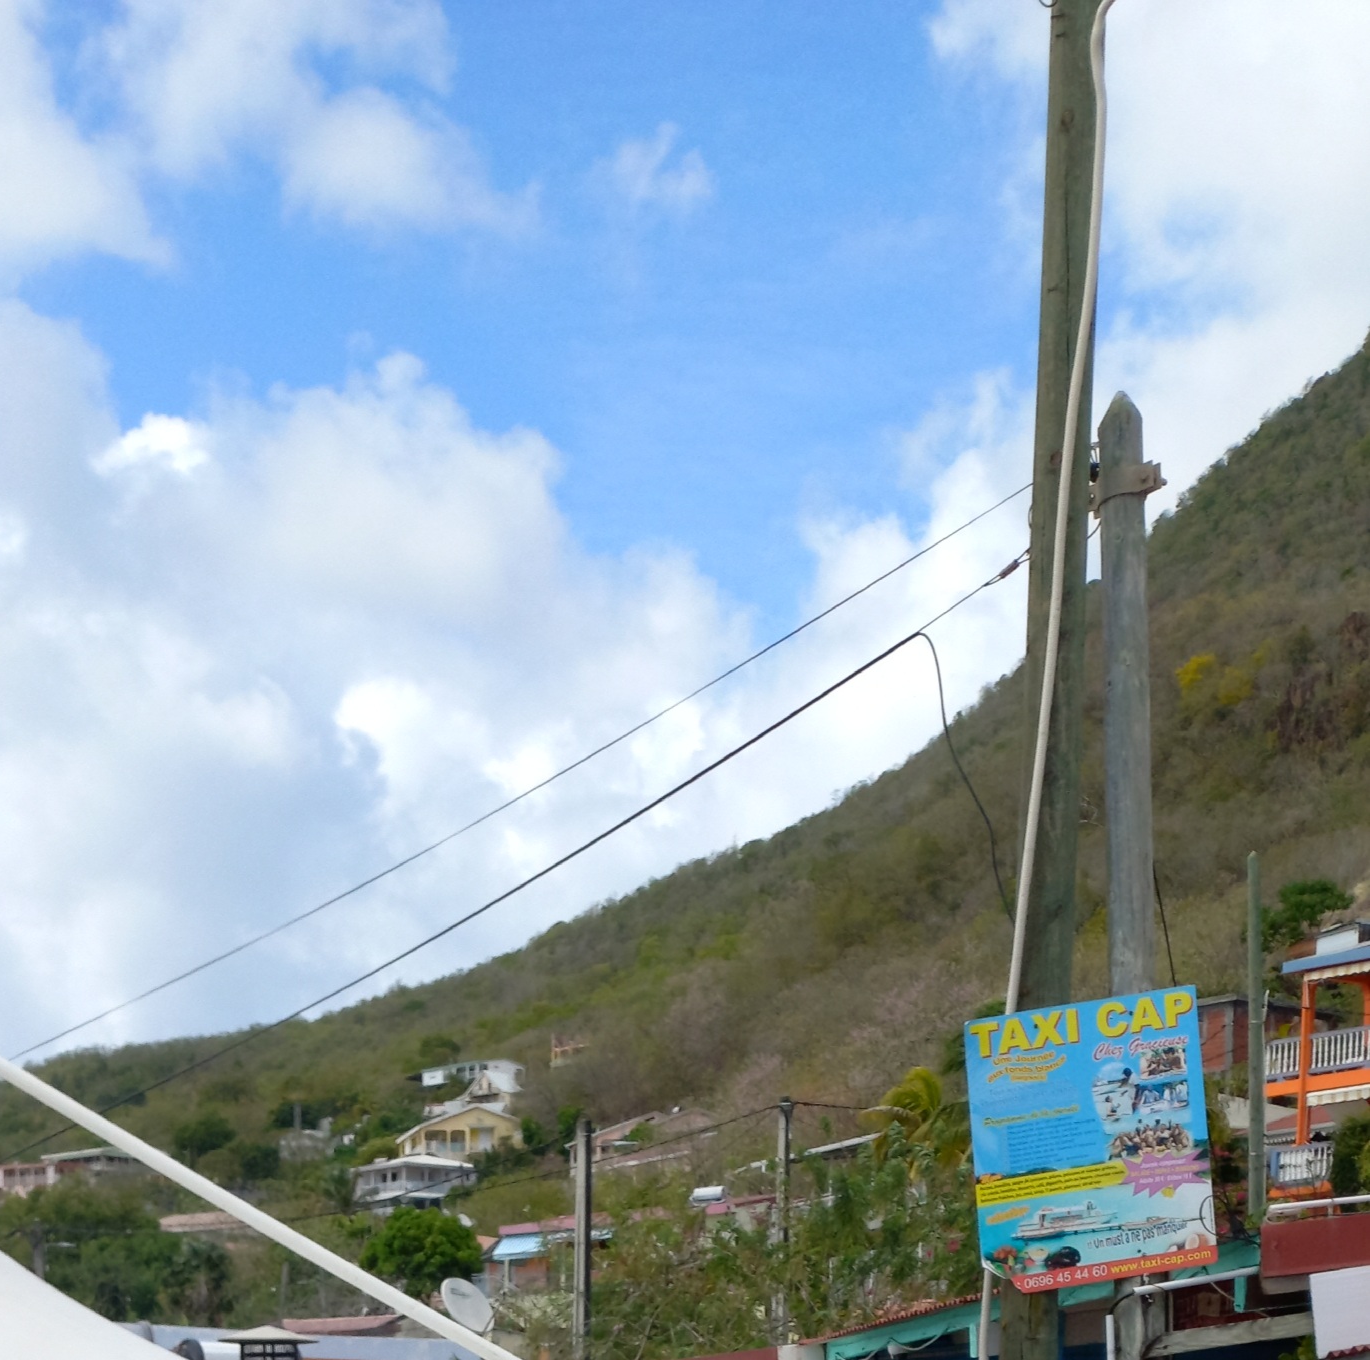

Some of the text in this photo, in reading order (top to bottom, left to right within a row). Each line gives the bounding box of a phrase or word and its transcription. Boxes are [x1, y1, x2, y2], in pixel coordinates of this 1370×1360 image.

[969, 991, 1193, 1058] TAXI CAP
[1093, 1034, 1189, 1061] Chez Gracieuse
[1131, 1229, 1141, 1243] ne
[1142, 1227, 1155, 1245] pas
[1023, 1249, 1212, 1290] 0696 45 44 60 www.taxi-cap.com
